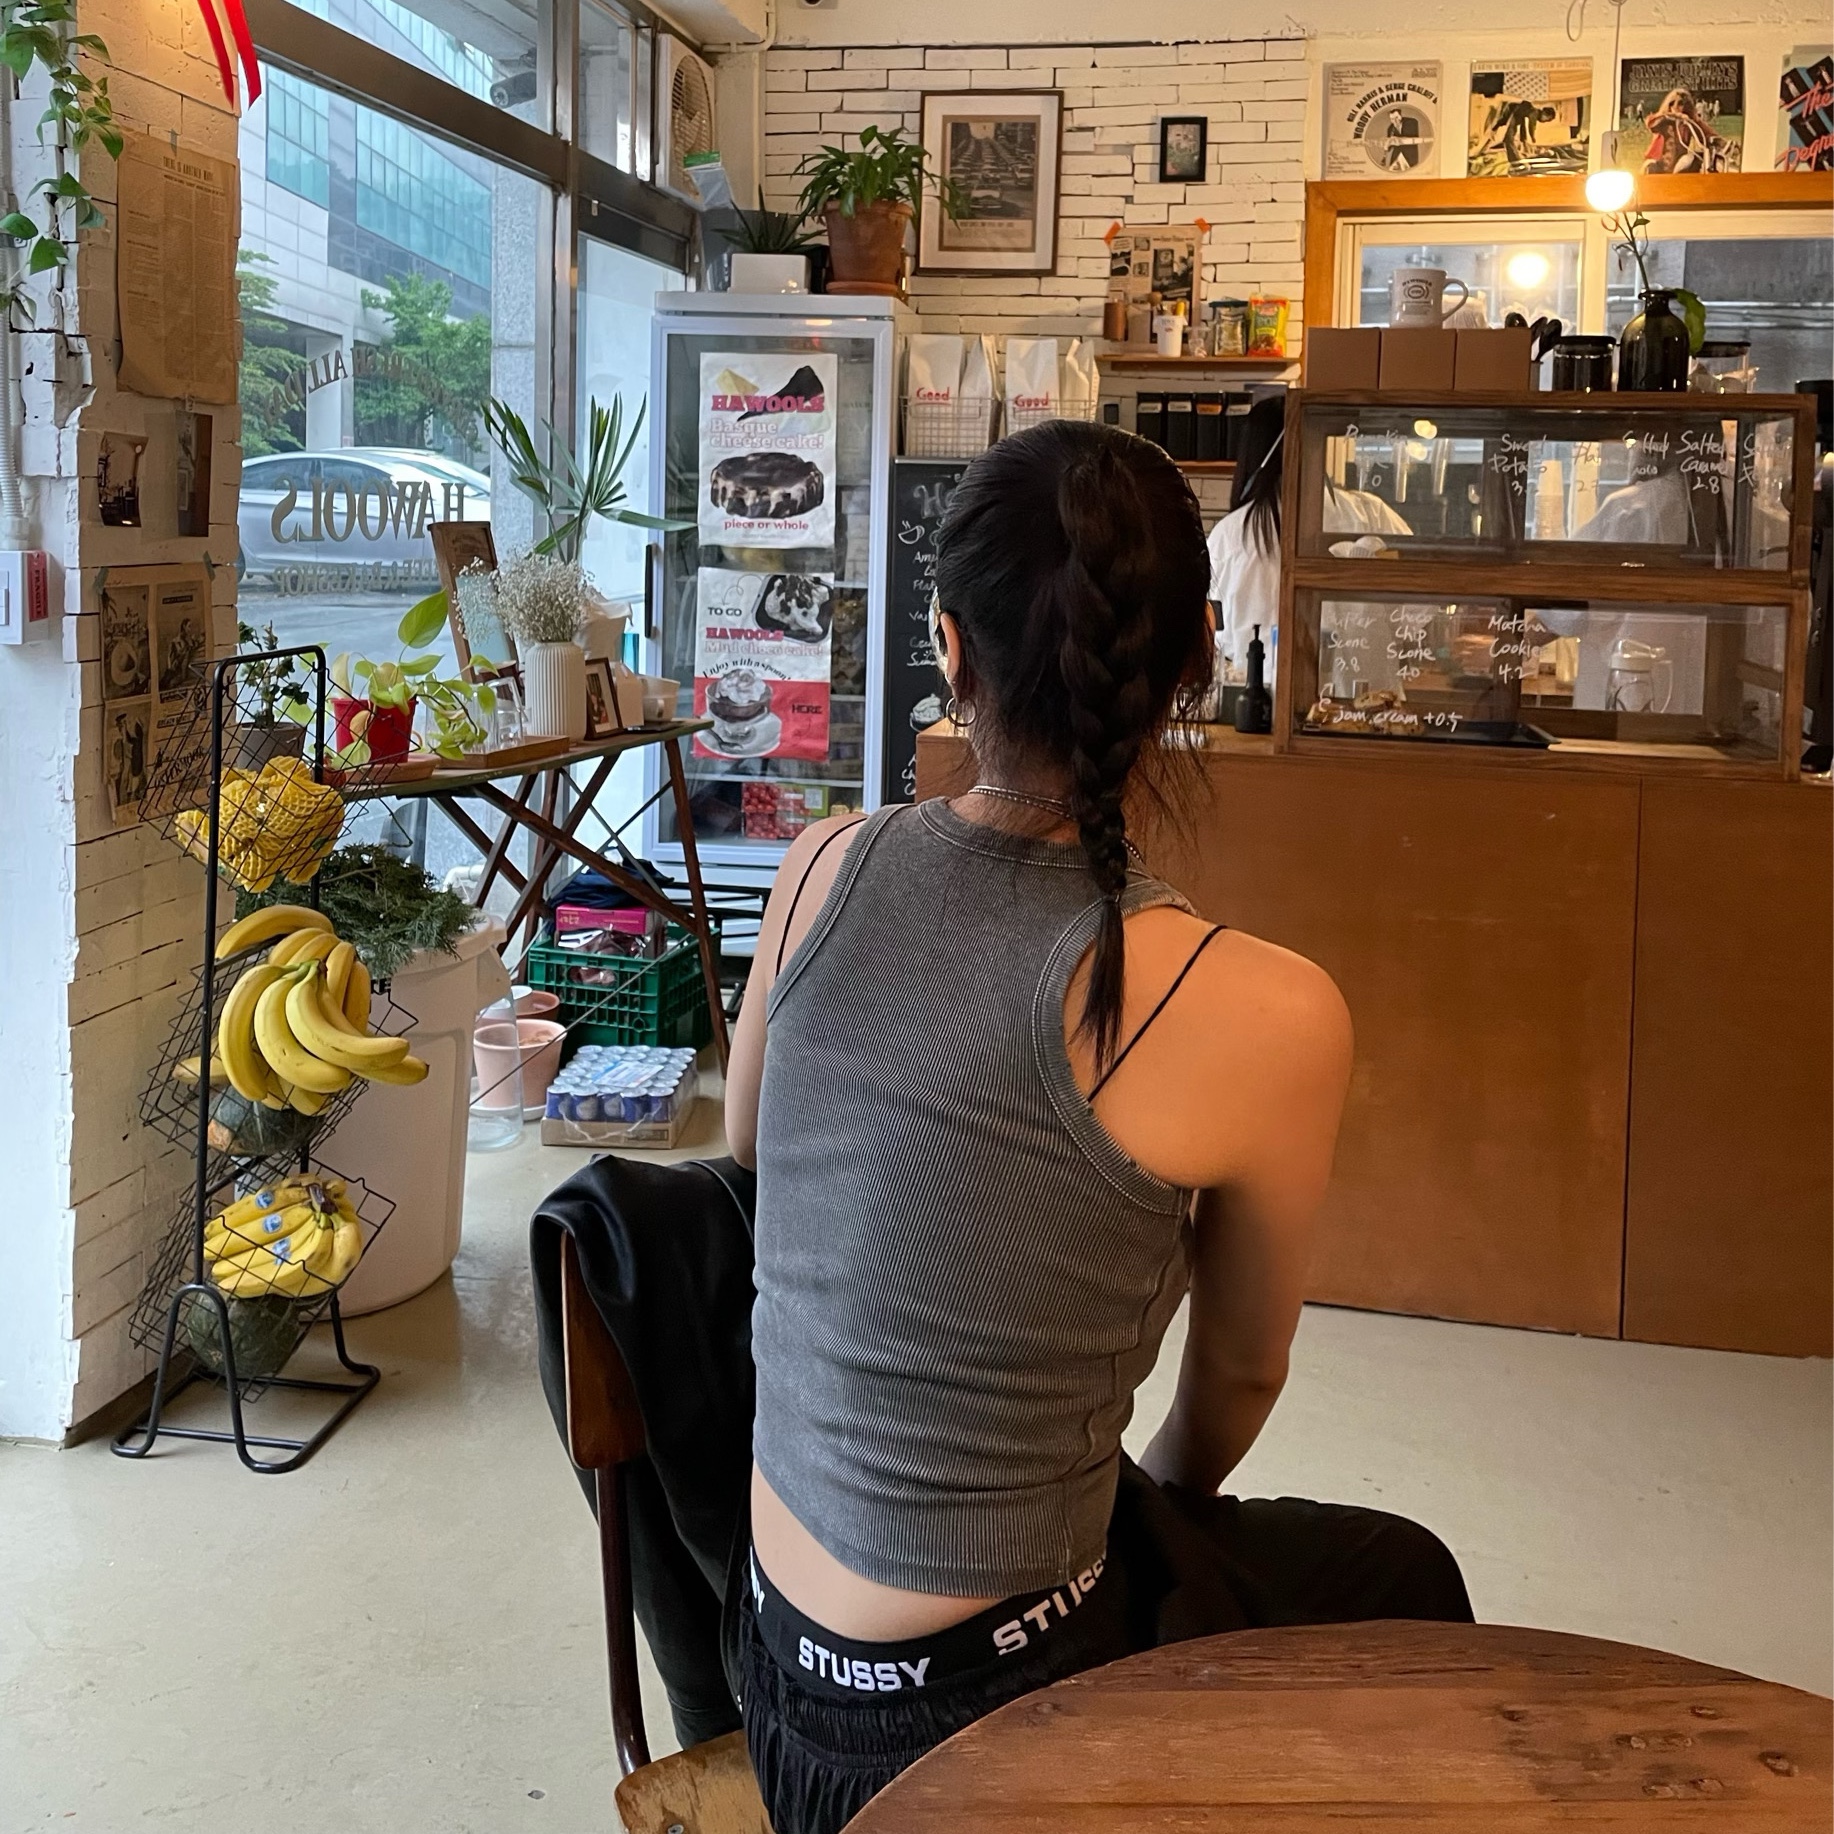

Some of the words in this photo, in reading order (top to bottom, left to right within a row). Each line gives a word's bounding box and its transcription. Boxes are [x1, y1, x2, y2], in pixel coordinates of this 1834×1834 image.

[1353, 110, 1372, 139] WOODY
[1369, 92, 1408, 113] HERMAN
[916, 387, 950, 402] Good
[1014, 392, 1049, 408] Good
[711, 395, 825, 414] HAWOOLS
[710, 417, 777, 436] Basque
[710, 432, 772, 449] cheese
[775, 434, 825, 450] cake!
[1676, 430, 1726, 458] Salted
[1693, 476, 1720, 494] 2.8
[724, 520, 755, 531] piece
[757, 521, 772, 529] or
[773, 519, 809, 531] whole
[33, 568, 43, 618] FRAGILE
[707, 606, 724, 617] TO
[1390, 607, 1434, 625] Choco
[705, 627, 785, 643] HAWOOLS
[1328, 631, 1371, 650] Scone
[705, 640, 740, 655] Mud
[1386, 643, 1436, 661] Scone
[1335, 656, 1361, 673] 3.8
[1498, 663, 1536, 685] 4.2
[792, 703, 823, 715] HERE
[798, 1635, 931, 1692] STUSSY
